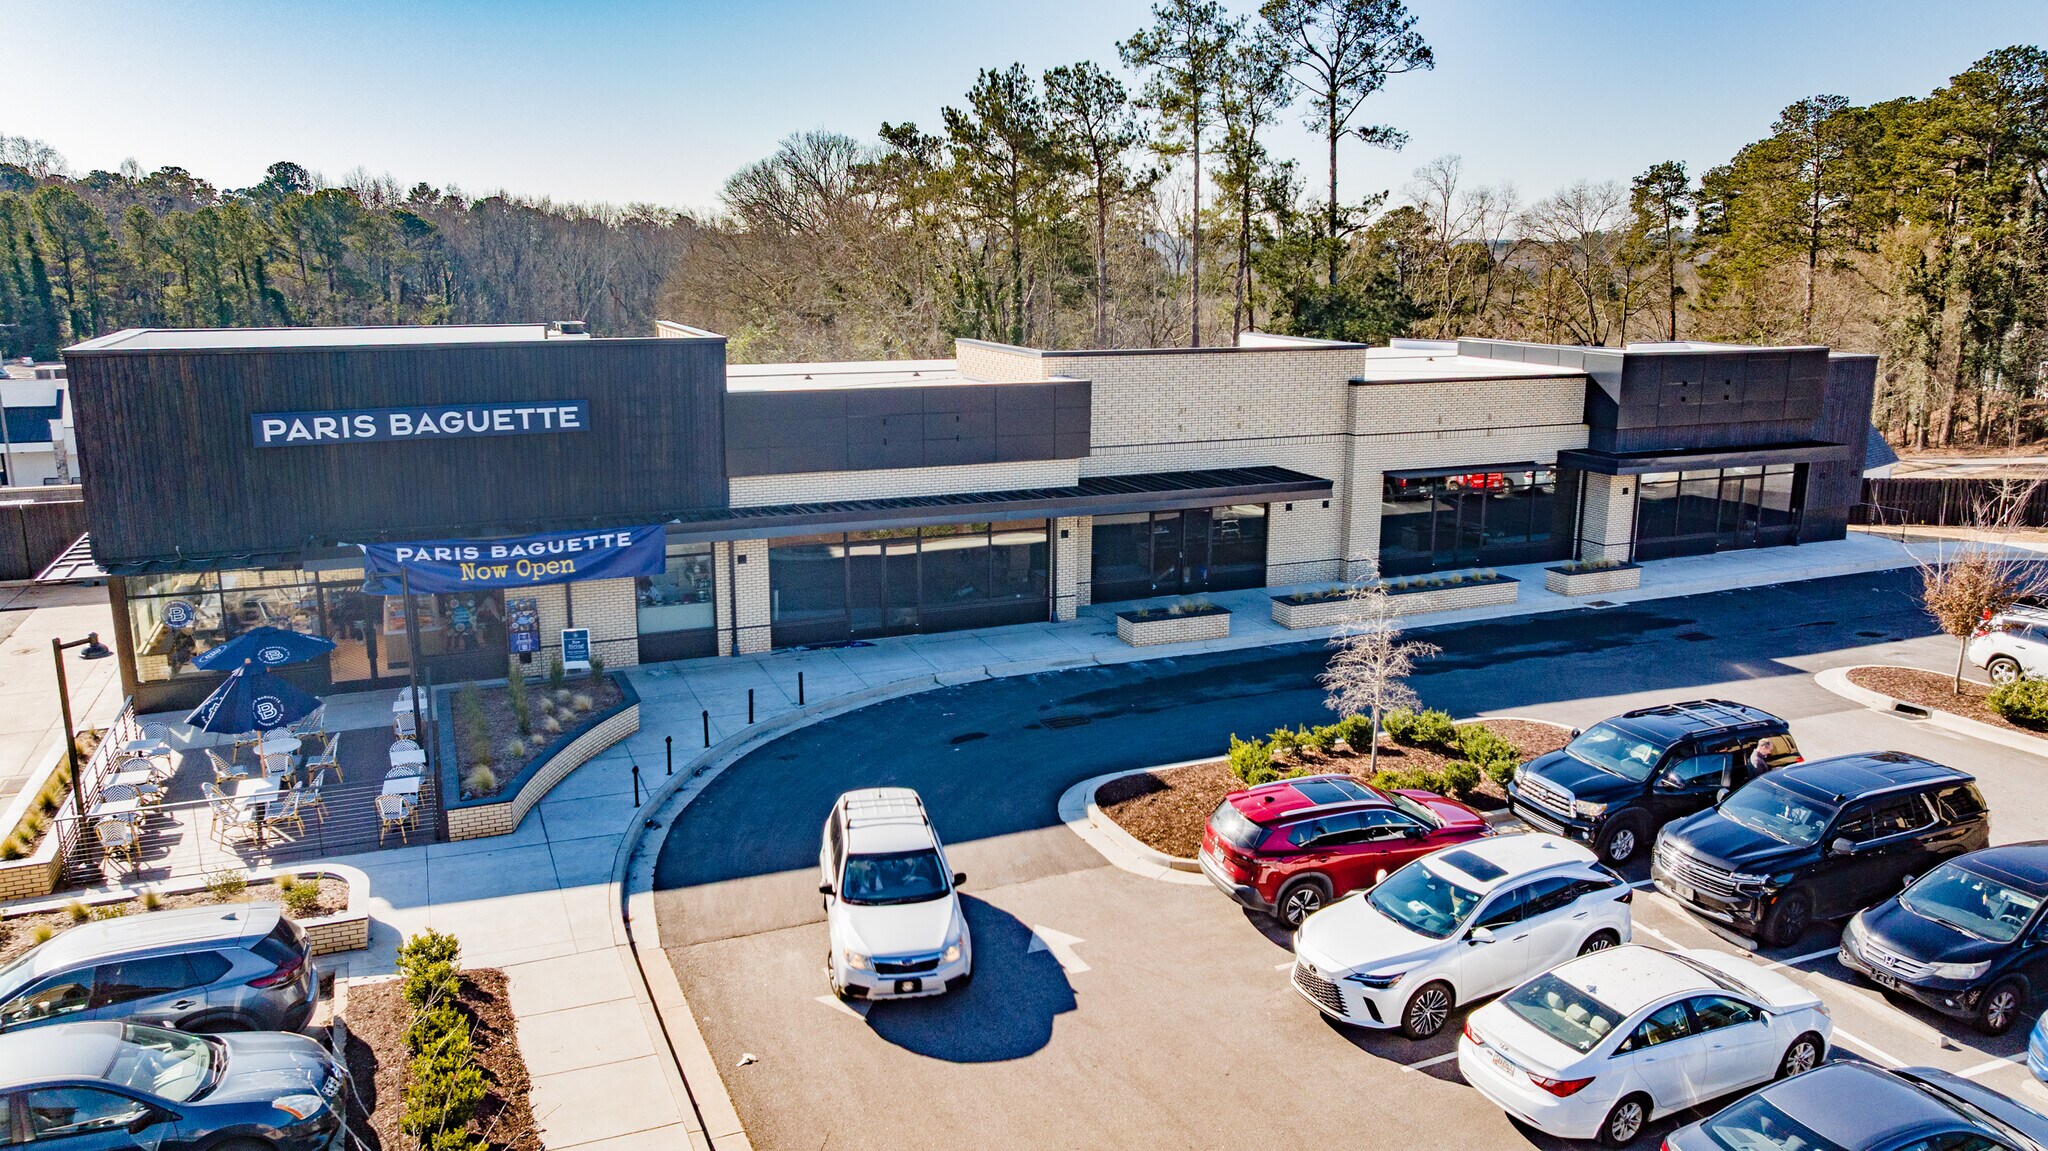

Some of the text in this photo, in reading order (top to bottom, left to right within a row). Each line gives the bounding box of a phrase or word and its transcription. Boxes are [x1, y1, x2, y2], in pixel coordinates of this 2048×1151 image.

[262, 406, 580, 442] PARIS BAGUETTE
[396, 532, 633, 562] PARIS BAGUETTE
[460, 558, 577, 581] Now Open
[169, 607, 187, 622] B
[257, 702, 278, 720] B
